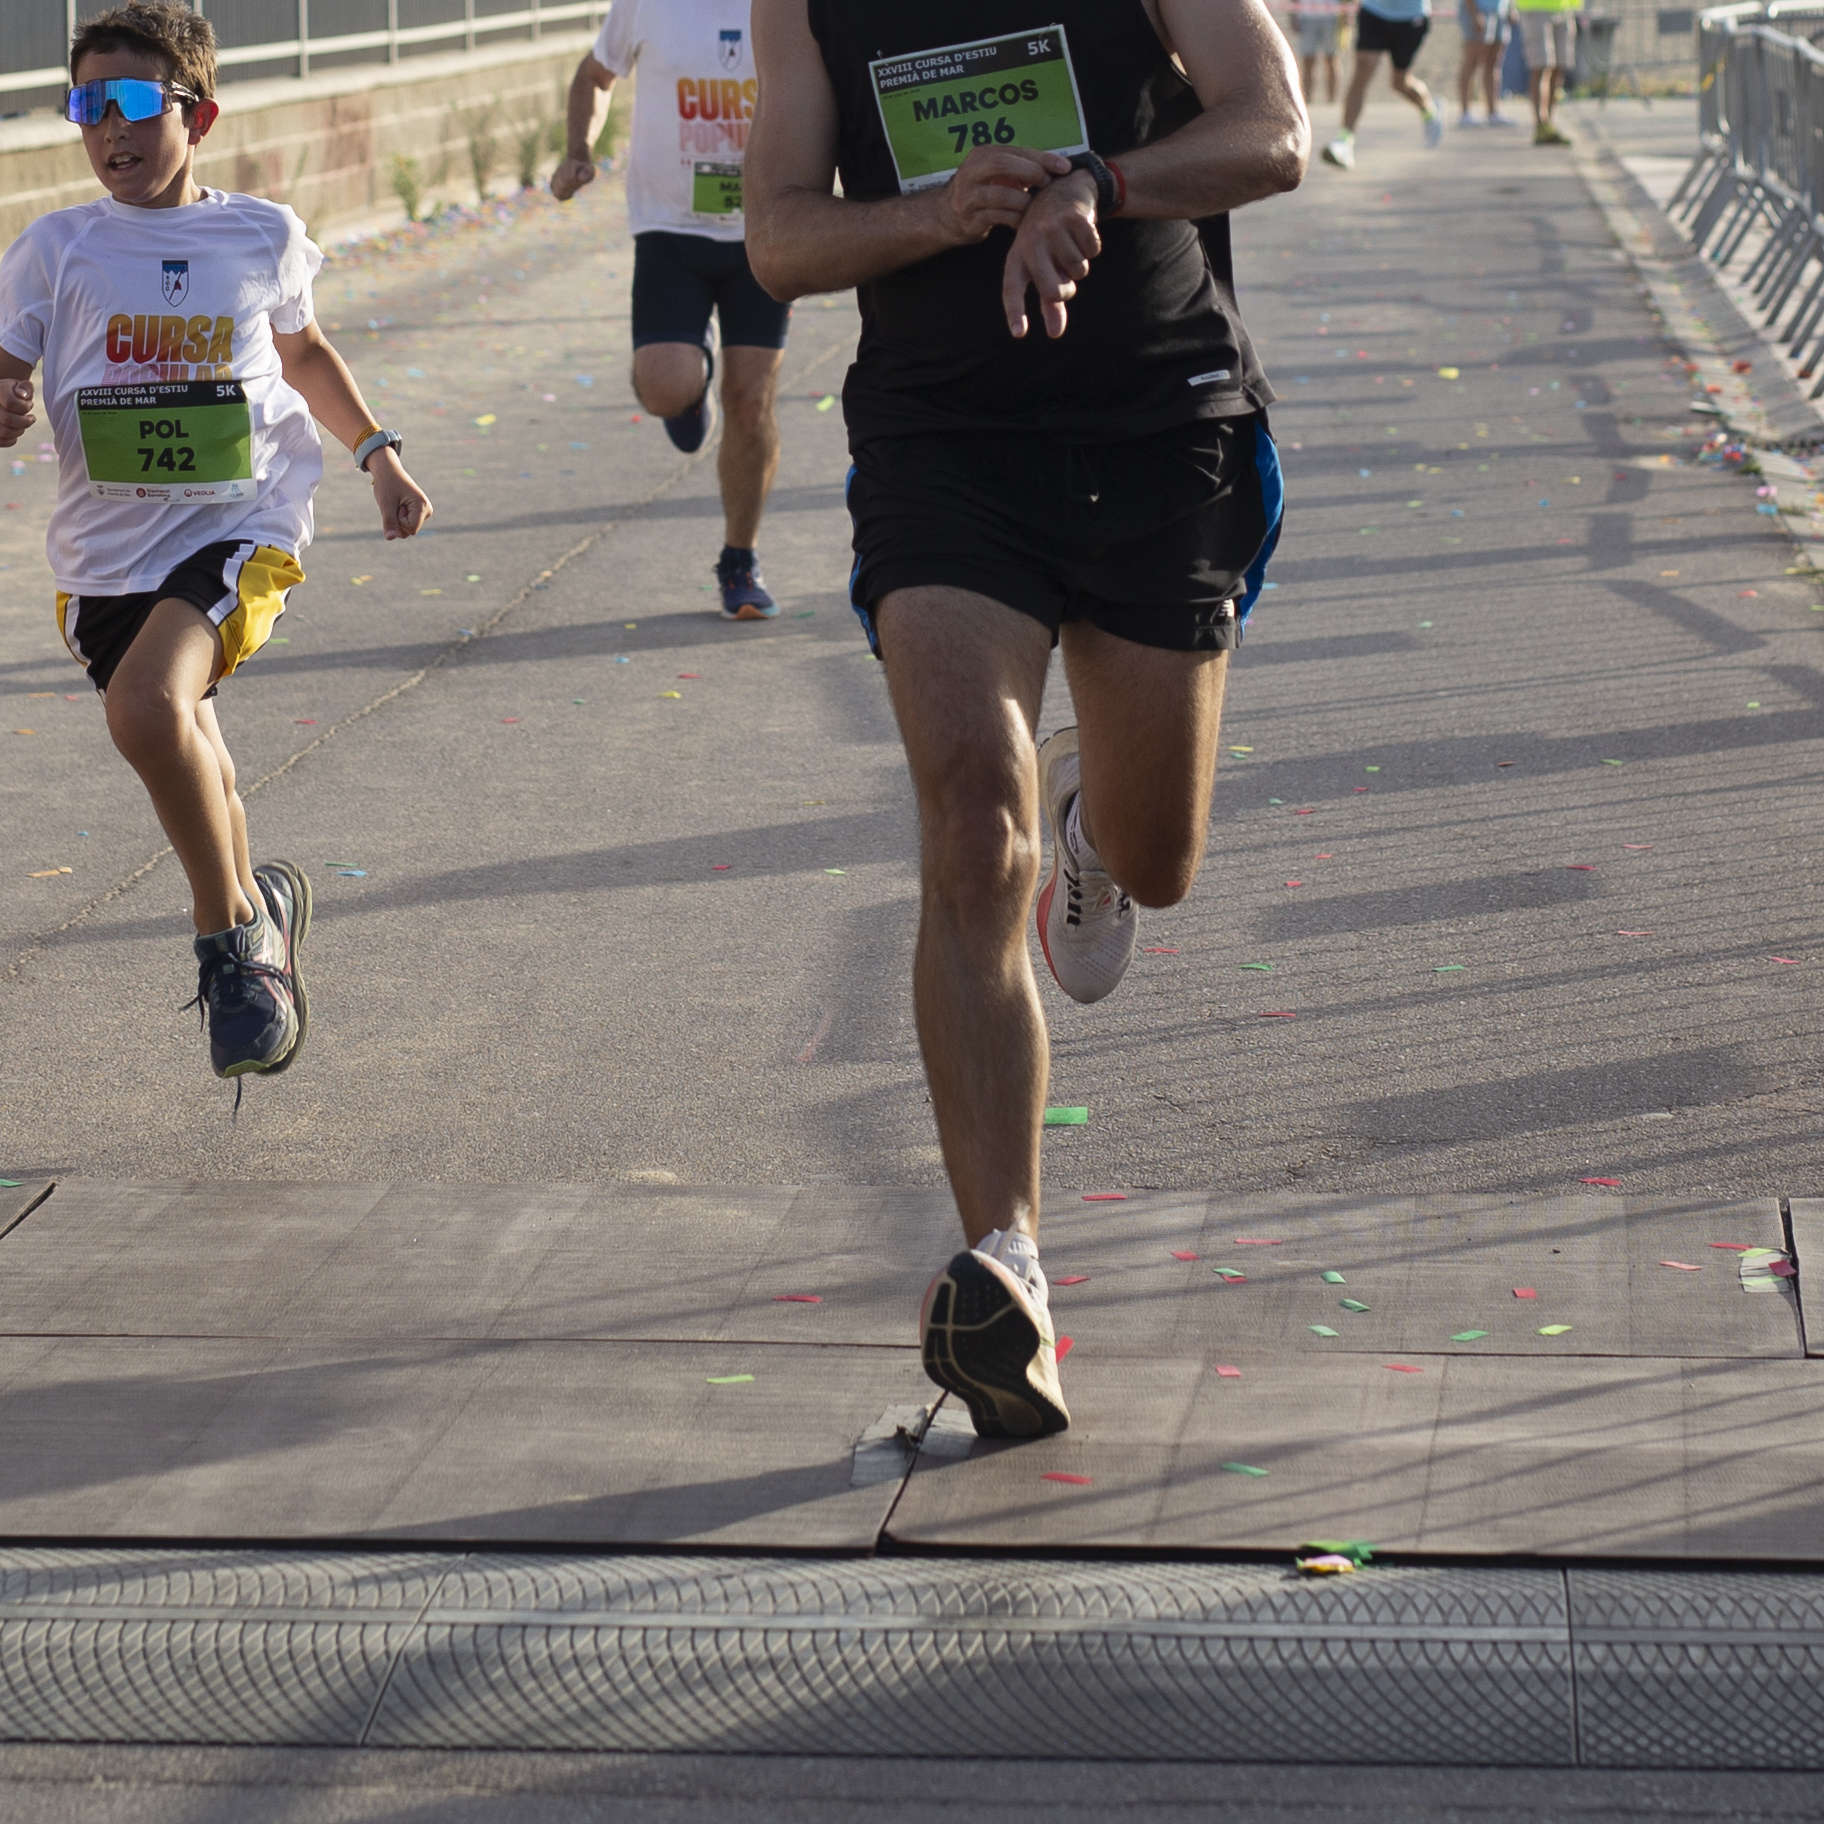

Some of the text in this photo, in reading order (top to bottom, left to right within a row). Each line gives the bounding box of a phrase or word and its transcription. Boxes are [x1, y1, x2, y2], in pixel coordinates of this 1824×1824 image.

[1027, 38, 1052, 56] 5K
[877, 46, 997, 78] XXVIII CURSA D'ESTIU
[879, 64, 965, 89] PREMIÀ DE MAR
[677, 76, 758, 122] CURS
[912, 78, 1040, 123] MARCOS
[948, 116, 1015, 154] 786
[105, 313, 235, 364] CURSA
[80, 384, 189, 397] XXVIII CURSA D'ESTIU
[80, 395, 157, 406] PREMIÀ DE MAR
[216, 384, 237, 397] 5K
[139, 419, 189, 440] POL
[137, 446, 196, 473] 742
